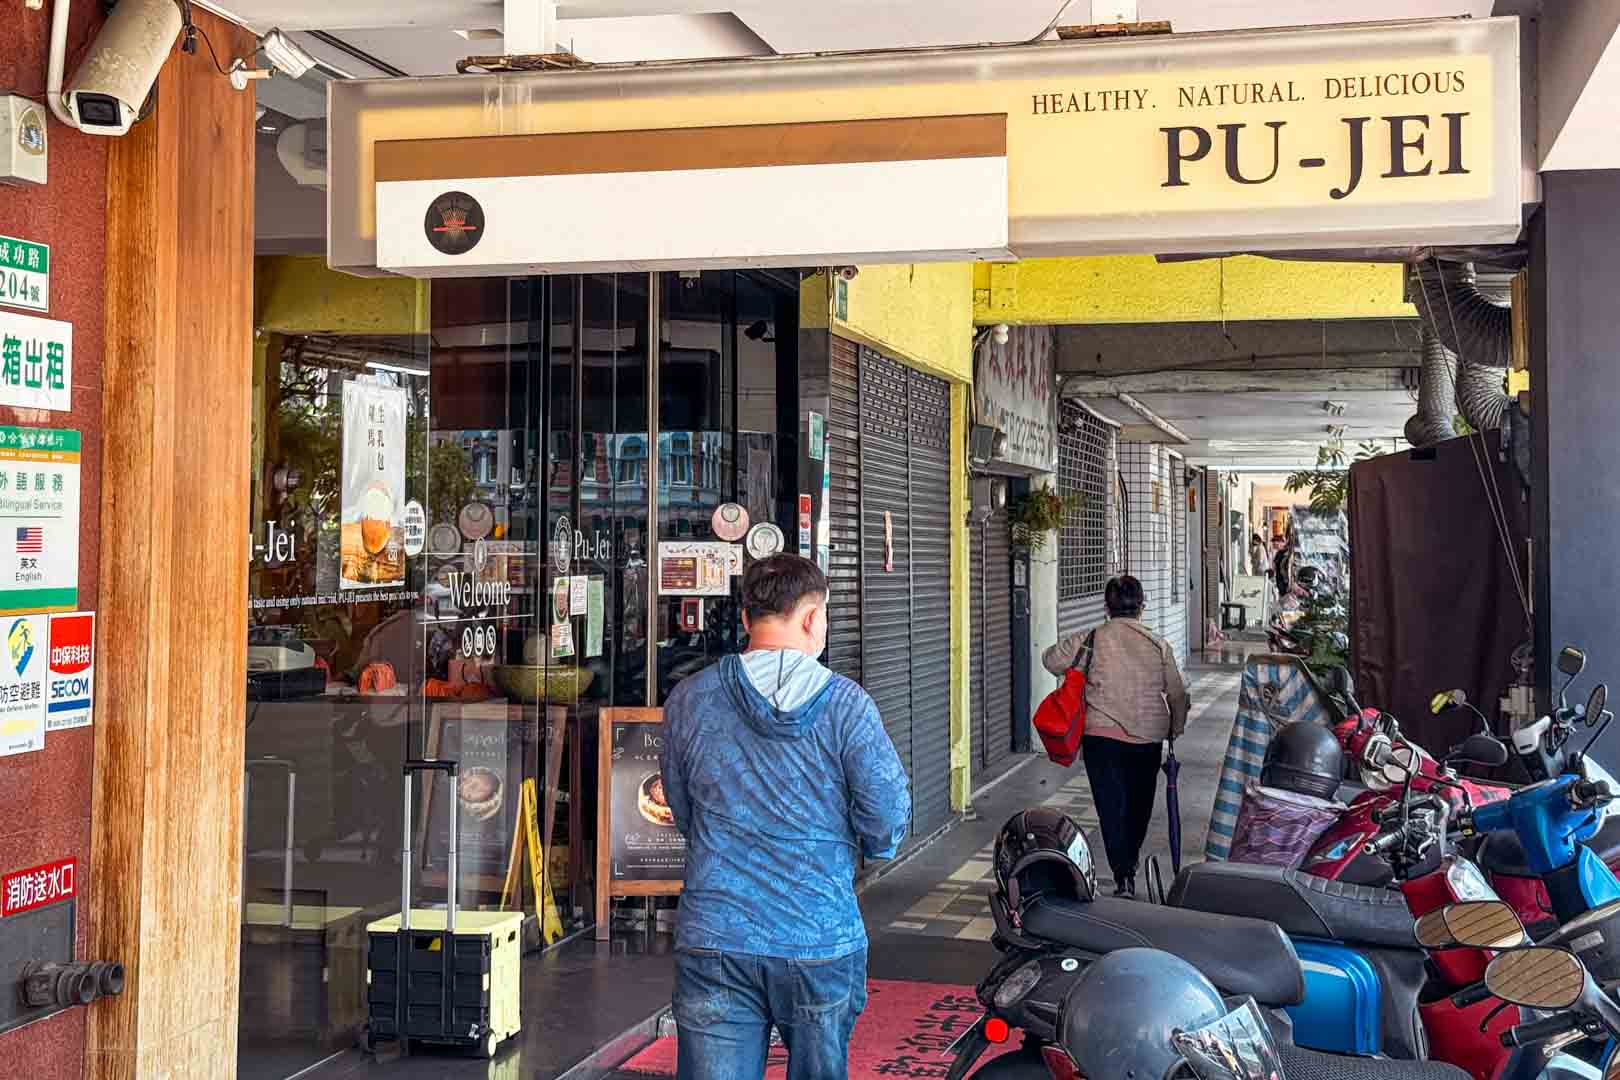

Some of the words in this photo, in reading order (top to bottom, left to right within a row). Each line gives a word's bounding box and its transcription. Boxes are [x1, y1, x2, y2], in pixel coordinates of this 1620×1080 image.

[1032, 88, 1156, 114] HEALTHY.
[1178, 80, 1305, 108] NATURAL.
[1325, 70, 1465, 101] DELICIOUS
[1159, 112, 1471, 200] PU-JEI
[2, 333, 65, 390] 箱出租
[574, 529, 611, 560] Pu-Jei
[16, 573, 42, 584] English
[20, 558, 38, 569] 英文
[448, 571, 512, 609] Welcome
[51, 644, 90, 666] 中保科技
[0, 680, 41, 704] 防空避難
[51, 678, 89, 699] SECOM
[6, 863, 74, 911] 消防送水口
